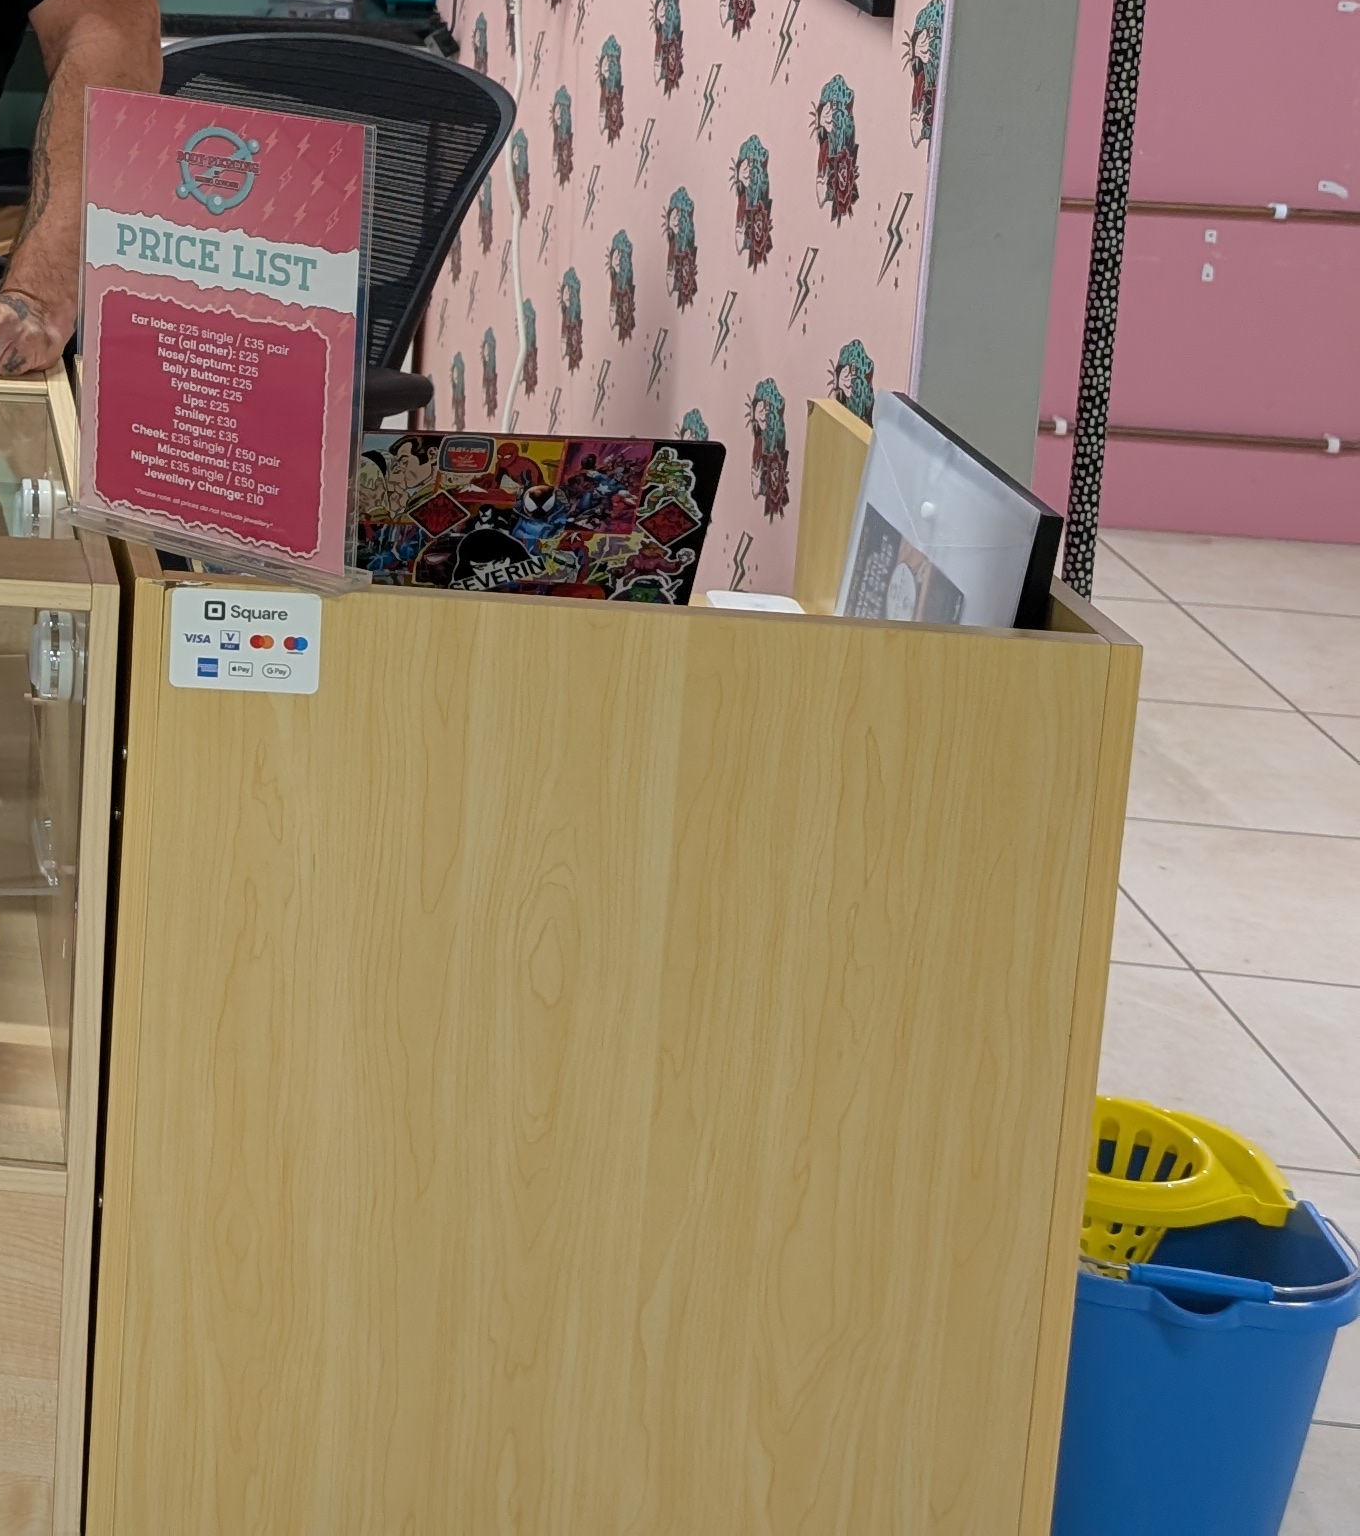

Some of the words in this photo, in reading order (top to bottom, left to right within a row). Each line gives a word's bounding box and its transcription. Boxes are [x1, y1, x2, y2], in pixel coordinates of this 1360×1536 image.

[116, 222, 221, 275] PRICE
[231, 244, 317, 293] LIST
[131, 313, 148, 325] Ear
[150, 316, 177, 331] lobe:
[179, 323, 199, 336] £25
[201, 328, 233, 344] single
[244, 337, 264, 350] £35
[266, 342, 290, 355] pair
[158, 333, 175, 344] Ear
[178, 335, 197, 350] (all
[198, 342, 237, 360] other):
[238, 350, 259, 363] £25
[157, 347, 236, 373] Nose/Septum:
[238, 364, 259, 377] £25
[162, 361, 189, 378] Belly
[190, 369, 230, 386] Button:
[232, 377, 253, 391] £25
[171, 377, 220, 397] Eyebrow:
[222, 389, 243, 402] £25
[182, 394, 208, 407] Lips:
[209, 400, 230, 413] £25
[172, 418, 217, 438] Tongue:
[218, 430, 239, 443] £35
[174, 406, 215, 425] Smiley:
[216, 415, 237, 429] £30
[131, 423, 169, 440] Cheek:
[171, 433, 191, 446] £35
[192, 438, 225, 454] single
[235, 448, 256, 461] £50
[258, 454, 281, 467] pair
[157, 443, 230, 469] Microdermal:
[232, 461, 253, 475] £35
[131, 449, 169, 467] Nipple:
[170, 459, 190, 473] £35
[191, 465, 224, 482] single
[234, 476, 255, 489] £50
[257, 482, 280, 495] pair
[144, 467, 196, 490] Jewellery
[197, 481, 245, 501] Change:
[246, 492, 264, 506] £10
[230, 604, 289, 622] Square
[183, 633, 212, 644] VISA
[237, 665, 250, 674] Pay
[274, 667, 288, 676] Pay
